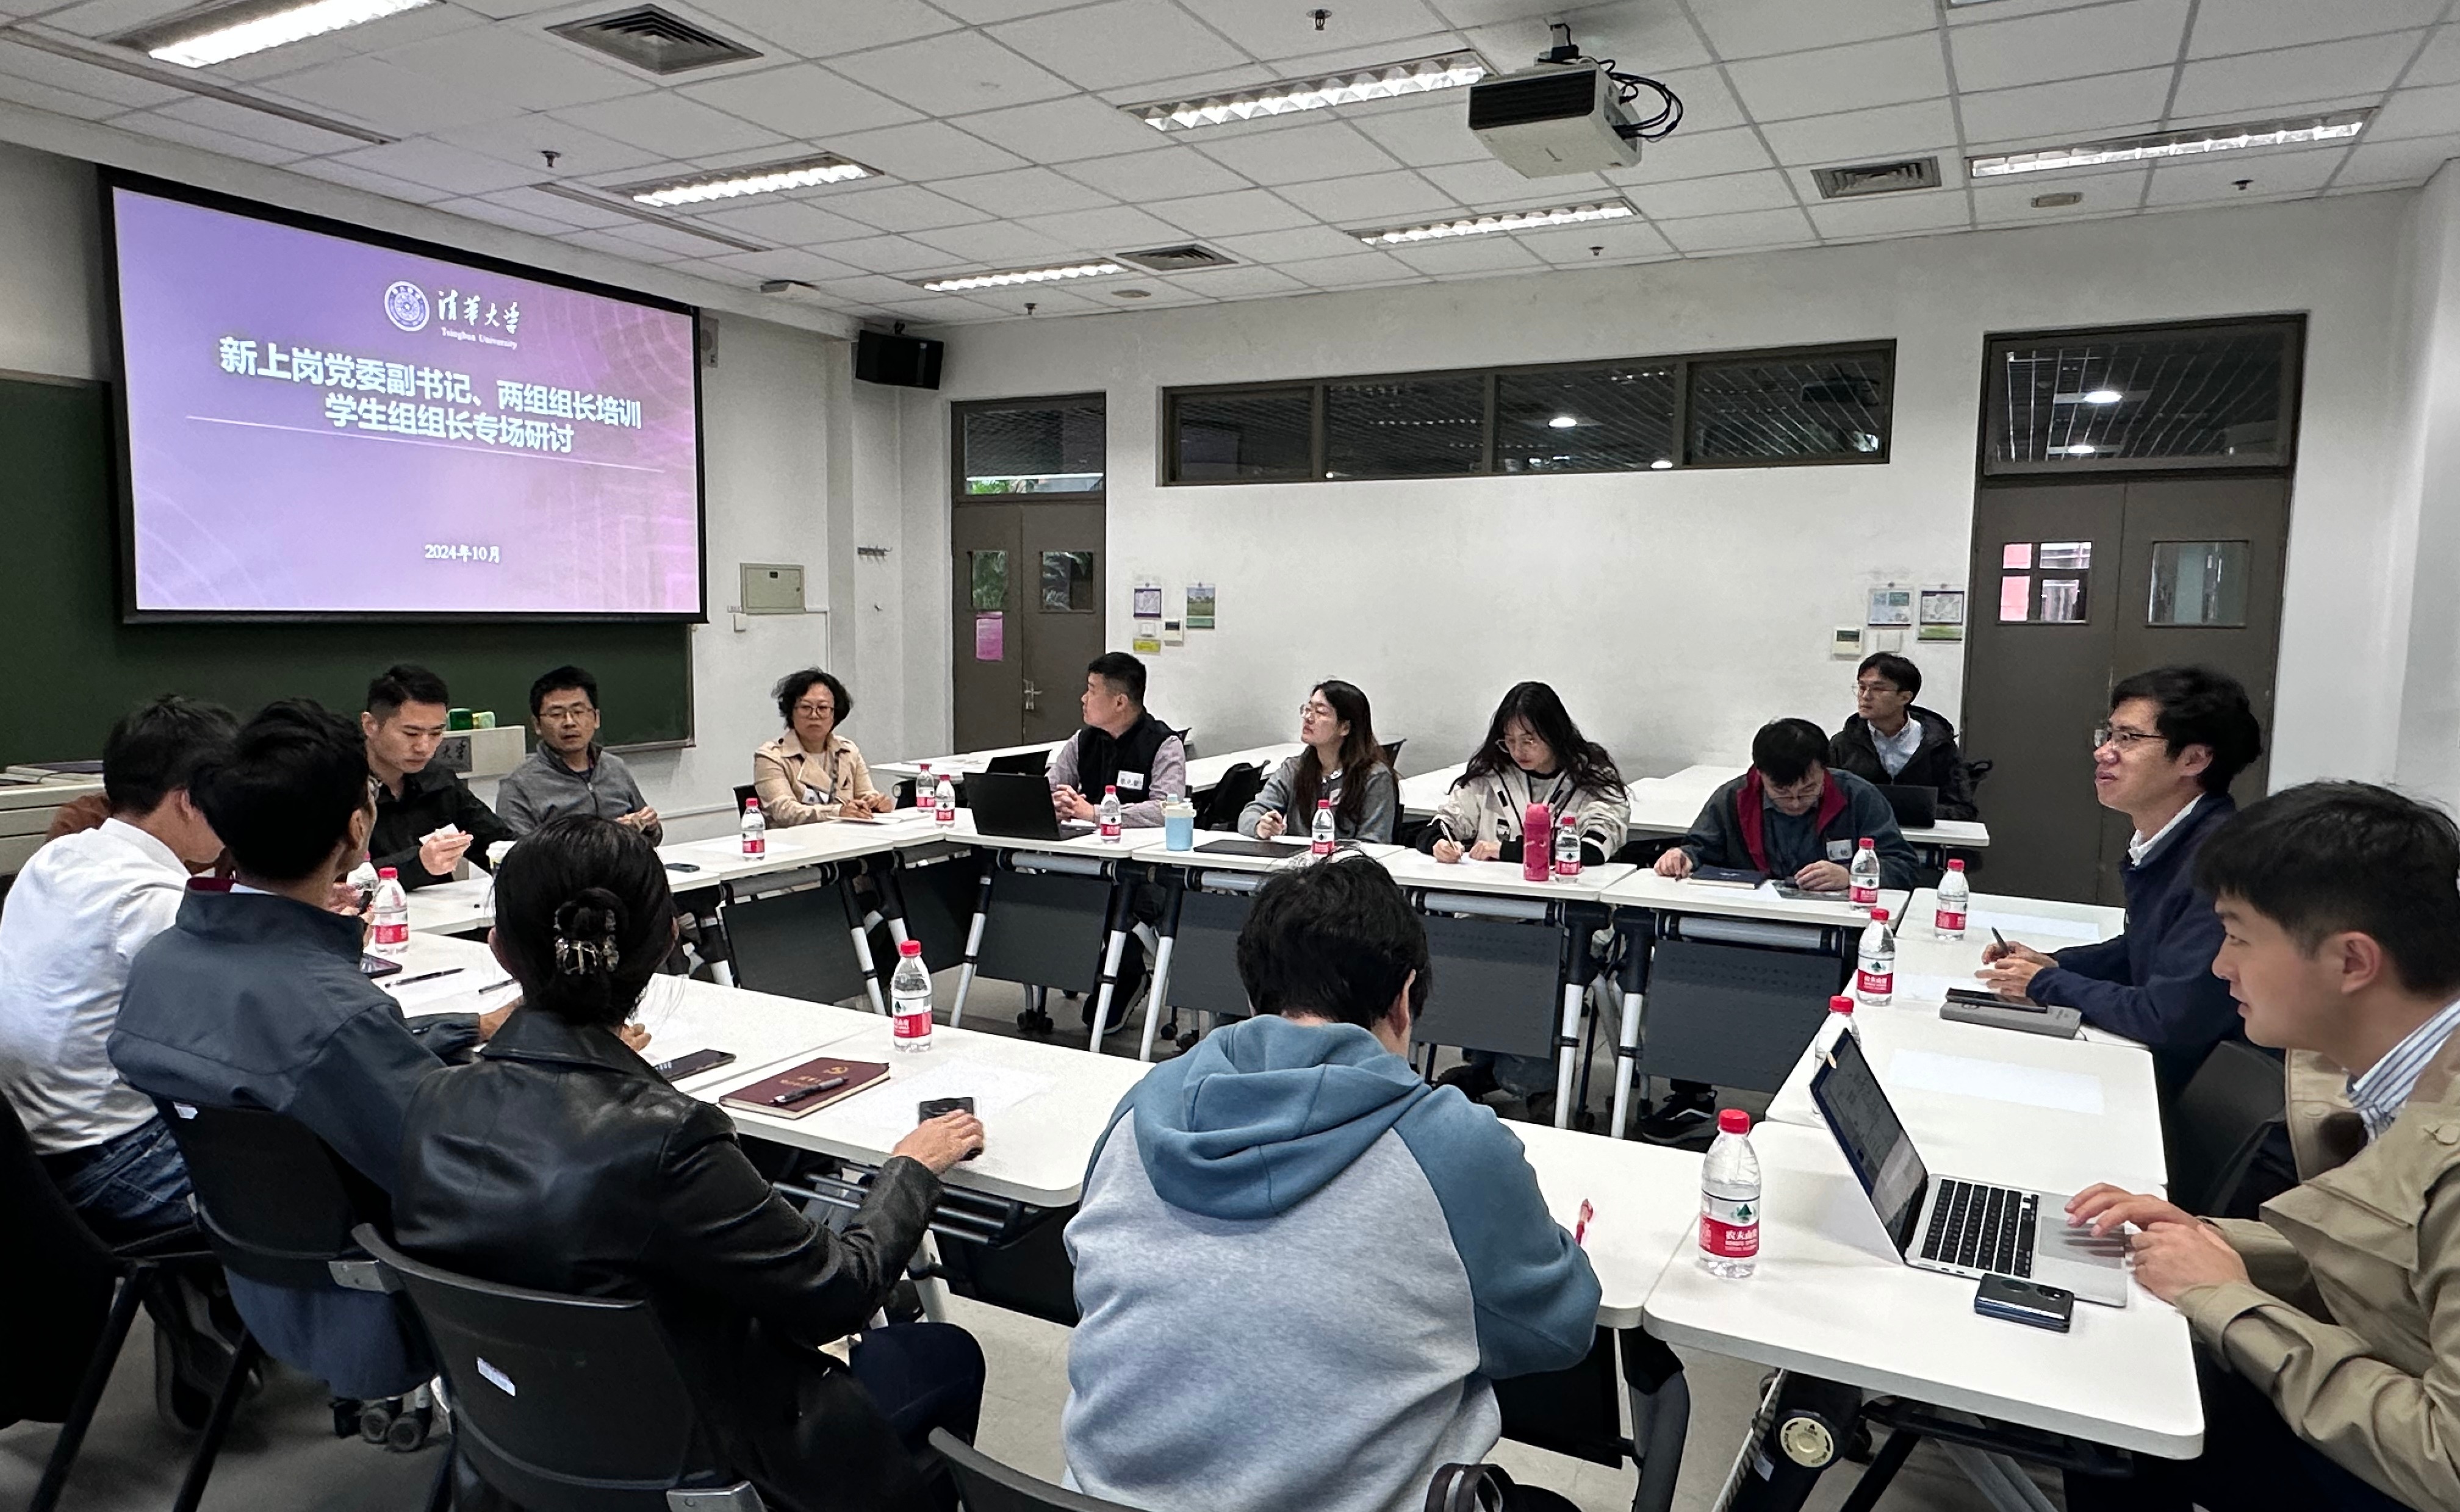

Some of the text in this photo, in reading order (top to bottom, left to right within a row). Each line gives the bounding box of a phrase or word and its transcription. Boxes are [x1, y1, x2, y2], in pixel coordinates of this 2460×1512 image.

[219, 336, 642, 429] 新上岗党委副书记、两组组长培训
[325, 392, 575, 453] 学生组组长专场研讨
[425, 544, 500, 563] 2024年10月
